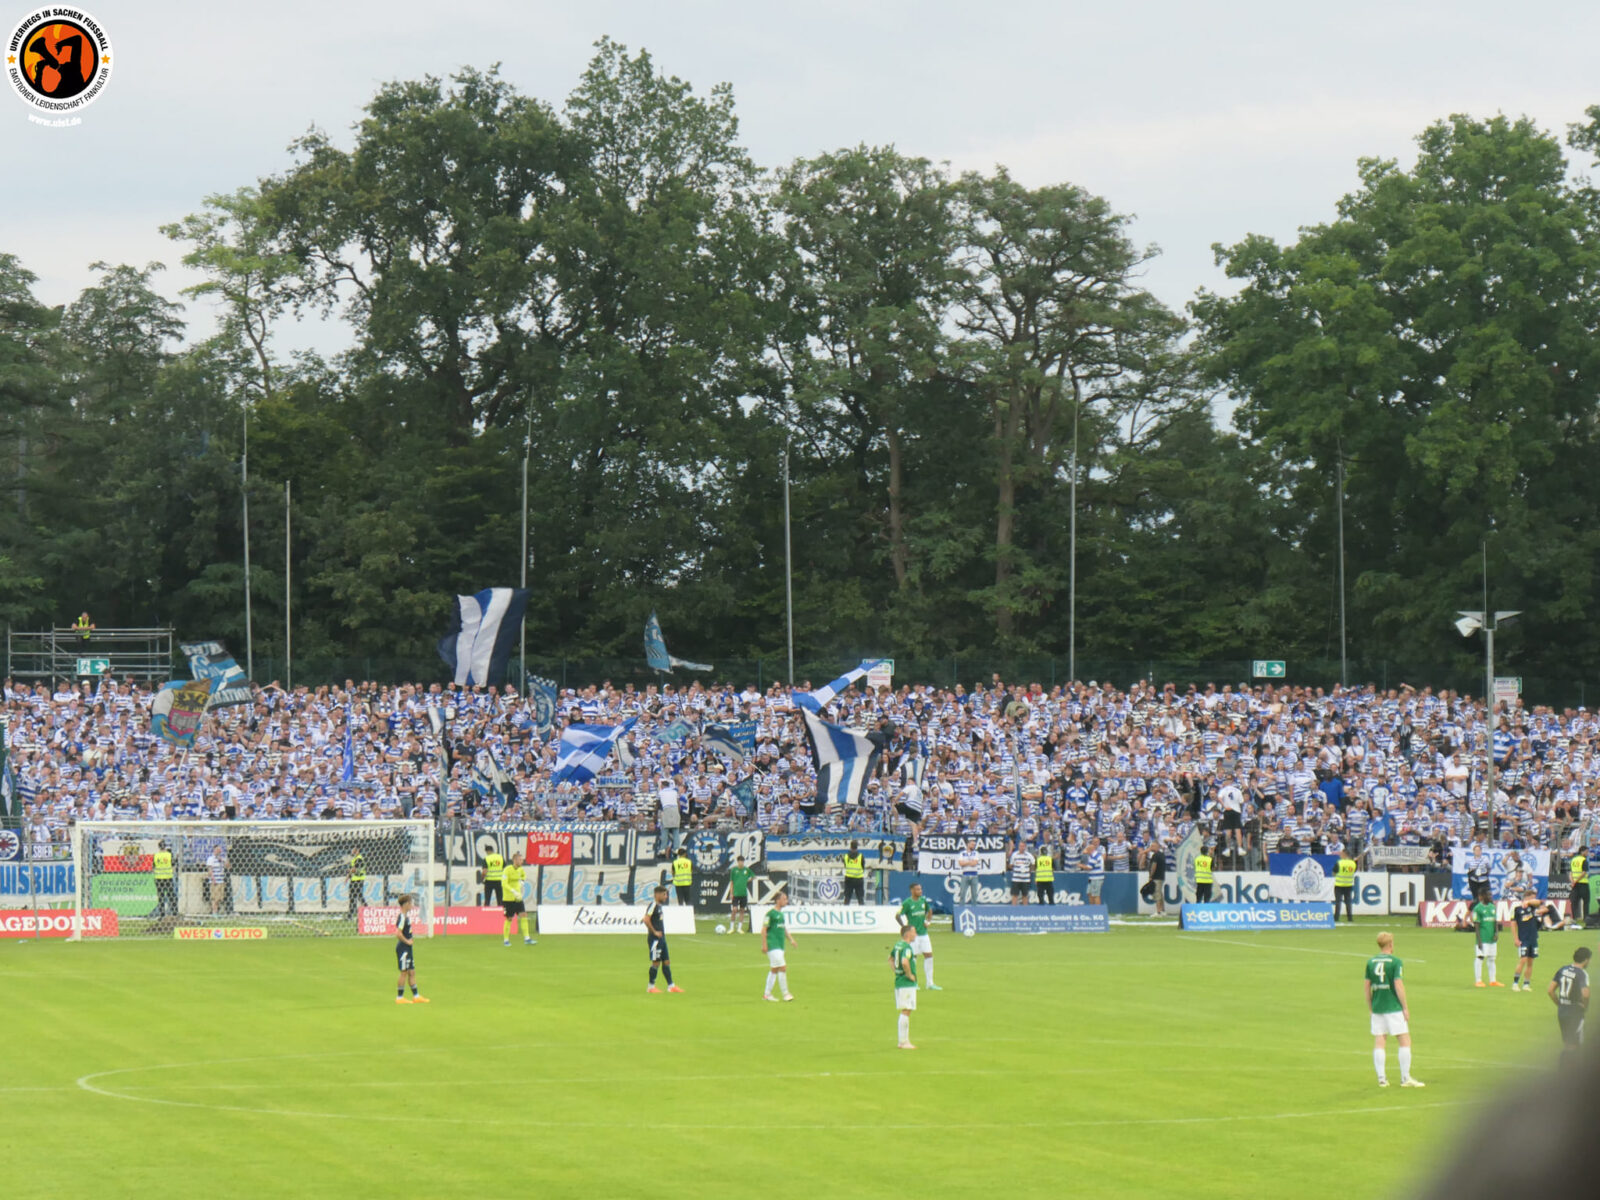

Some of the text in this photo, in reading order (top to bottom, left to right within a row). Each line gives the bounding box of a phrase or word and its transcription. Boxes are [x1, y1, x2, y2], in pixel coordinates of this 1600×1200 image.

[783, 907, 877, 926] TÖNNIES
[1197, 906, 1330, 922] euronics Bücker
[179, 929, 262, 939] WEST LOTTO
[1374, 962, 1386, 982] 4
[1559, 976, 1573, 998] 17
